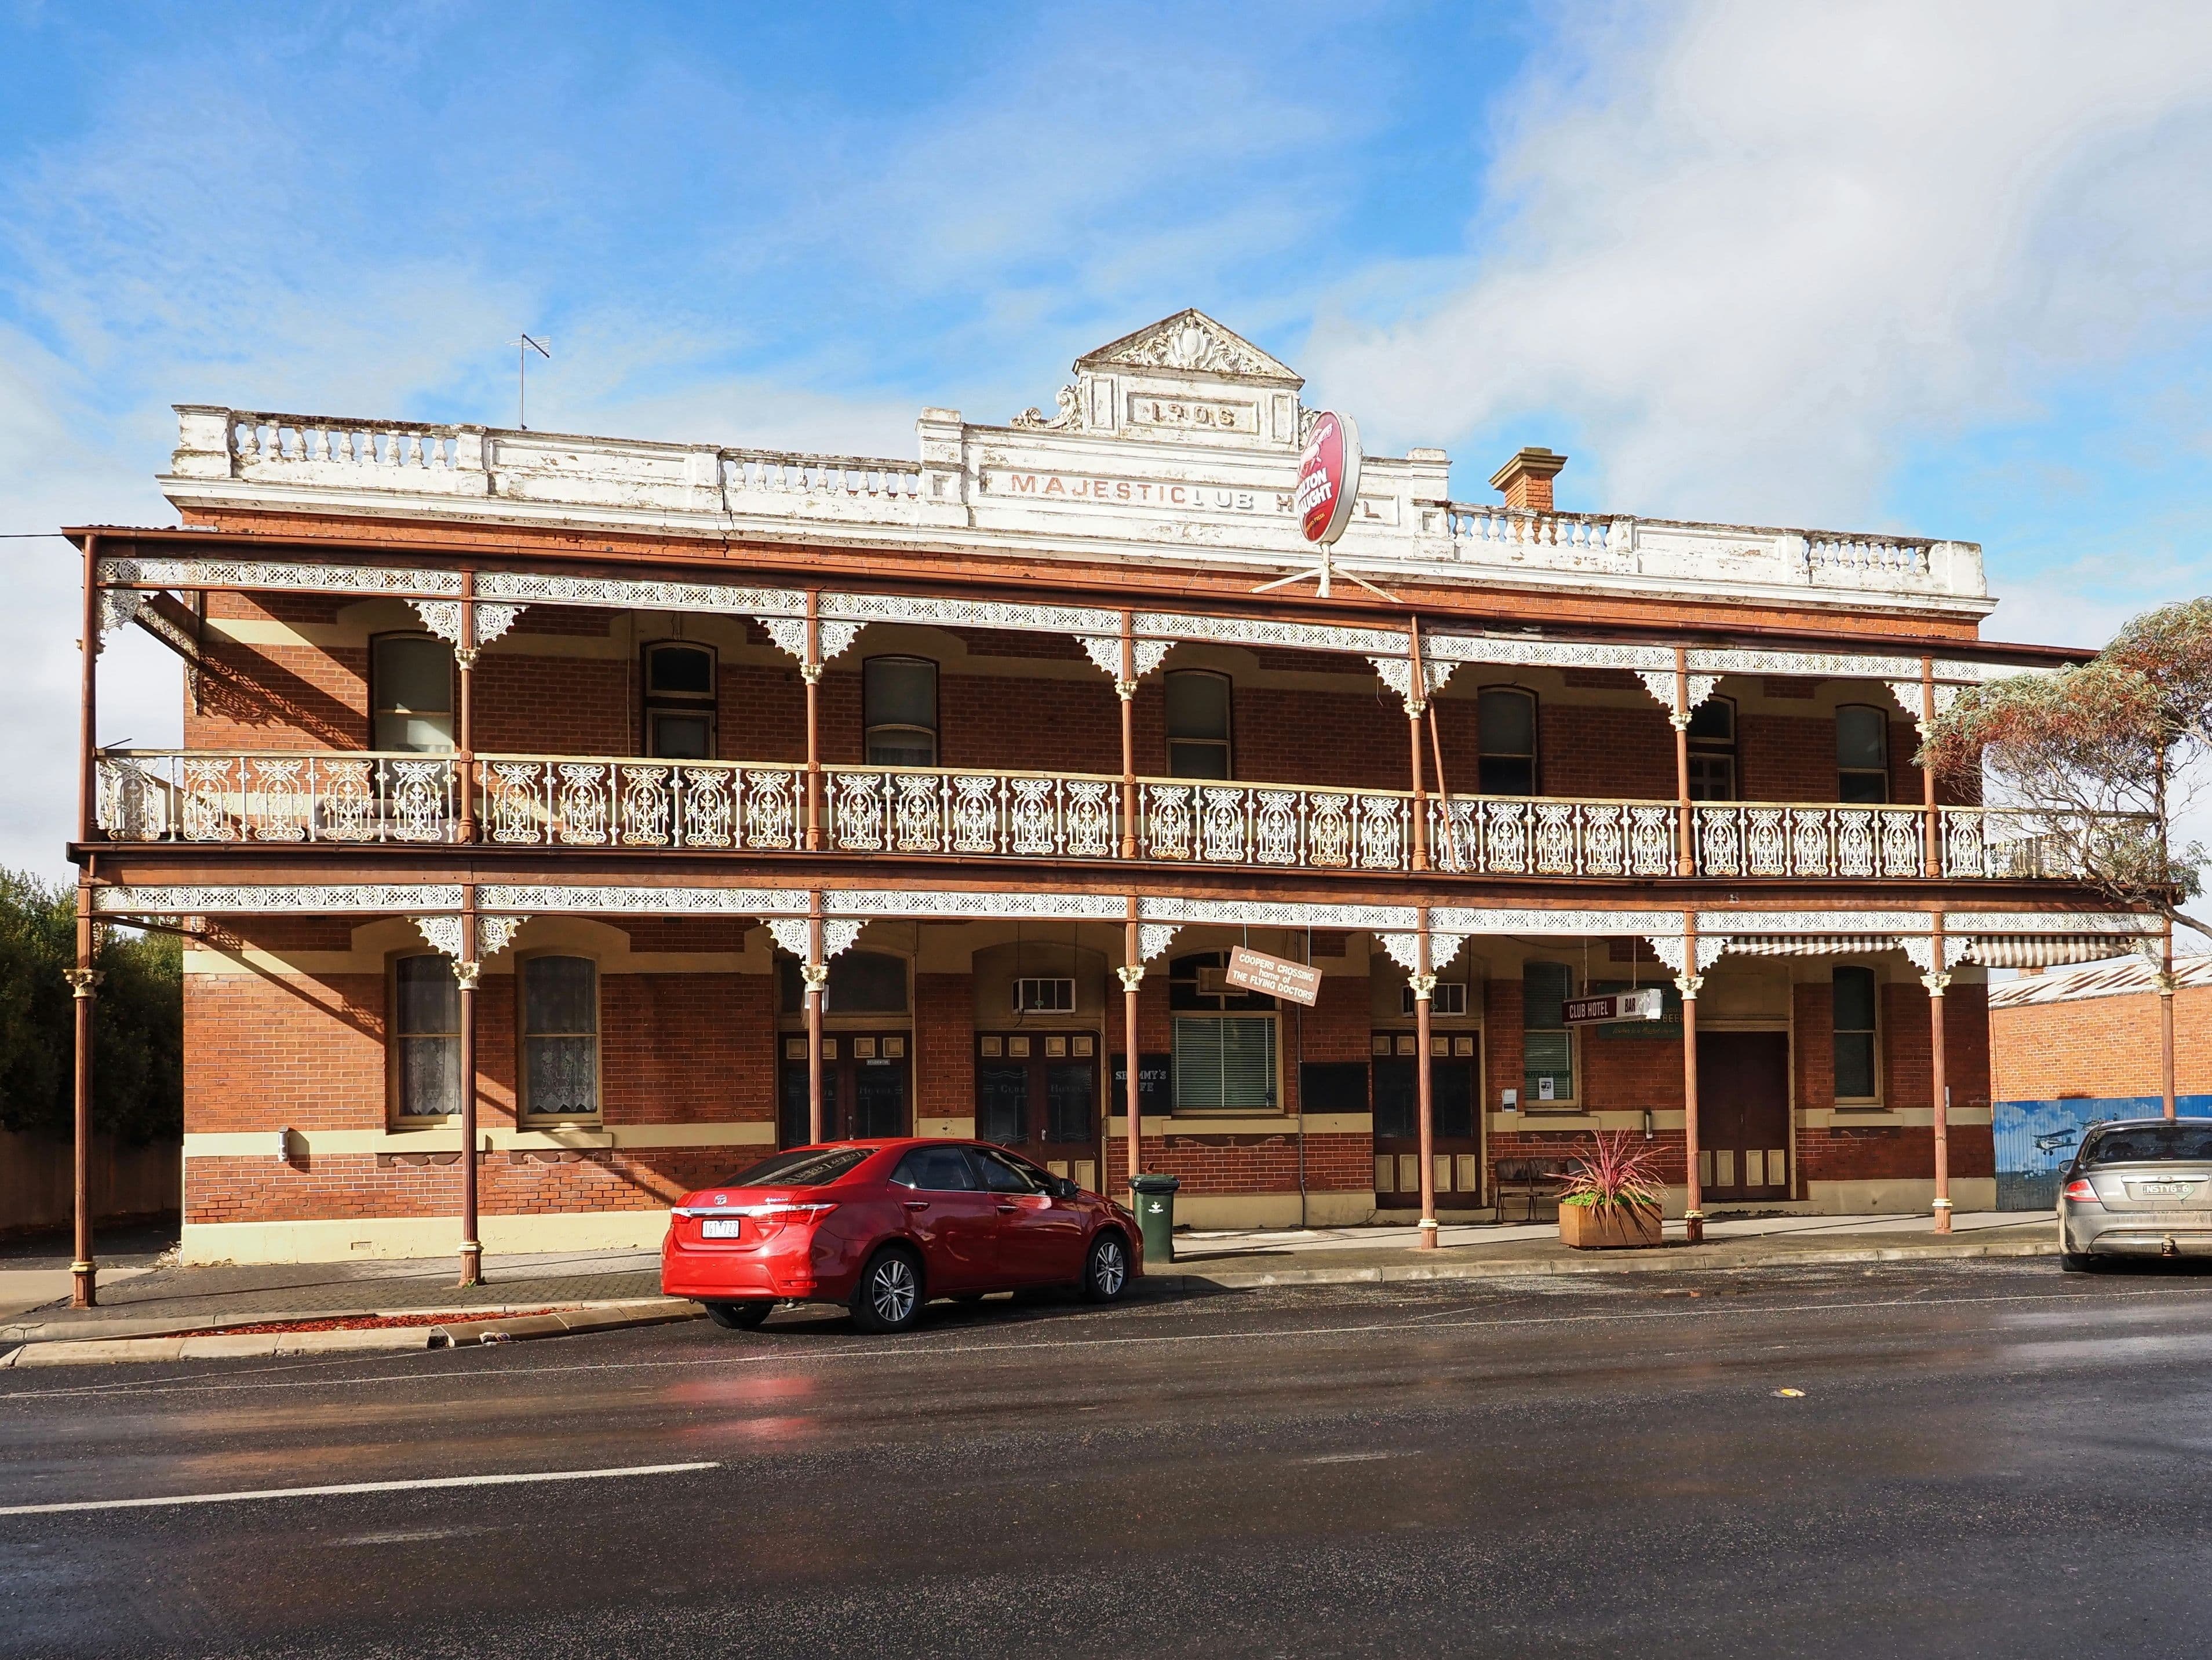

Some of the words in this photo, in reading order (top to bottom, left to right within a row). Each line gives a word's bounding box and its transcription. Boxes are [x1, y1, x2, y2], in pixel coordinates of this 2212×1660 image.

[1238, 953, 1275, 971] COOPERS
[1277, 964, 1315, 982] CROSSING
[1233, 970, 1248, 982] THE
[1249, 975, 1276, 990] FLYING
[1259, 969, 1280, 981] home
[1282, 975, 1292, 984] of
[1569, 1003, 1586, 1019] CLUB
[1588, 1001, 1609, 1017] HOTEL
[1624, 998, 1636, 1013] BAR
[1115, 1069, 1167, 1080] SMMY'S
[1125, 1082, 1154, 1092] FE
